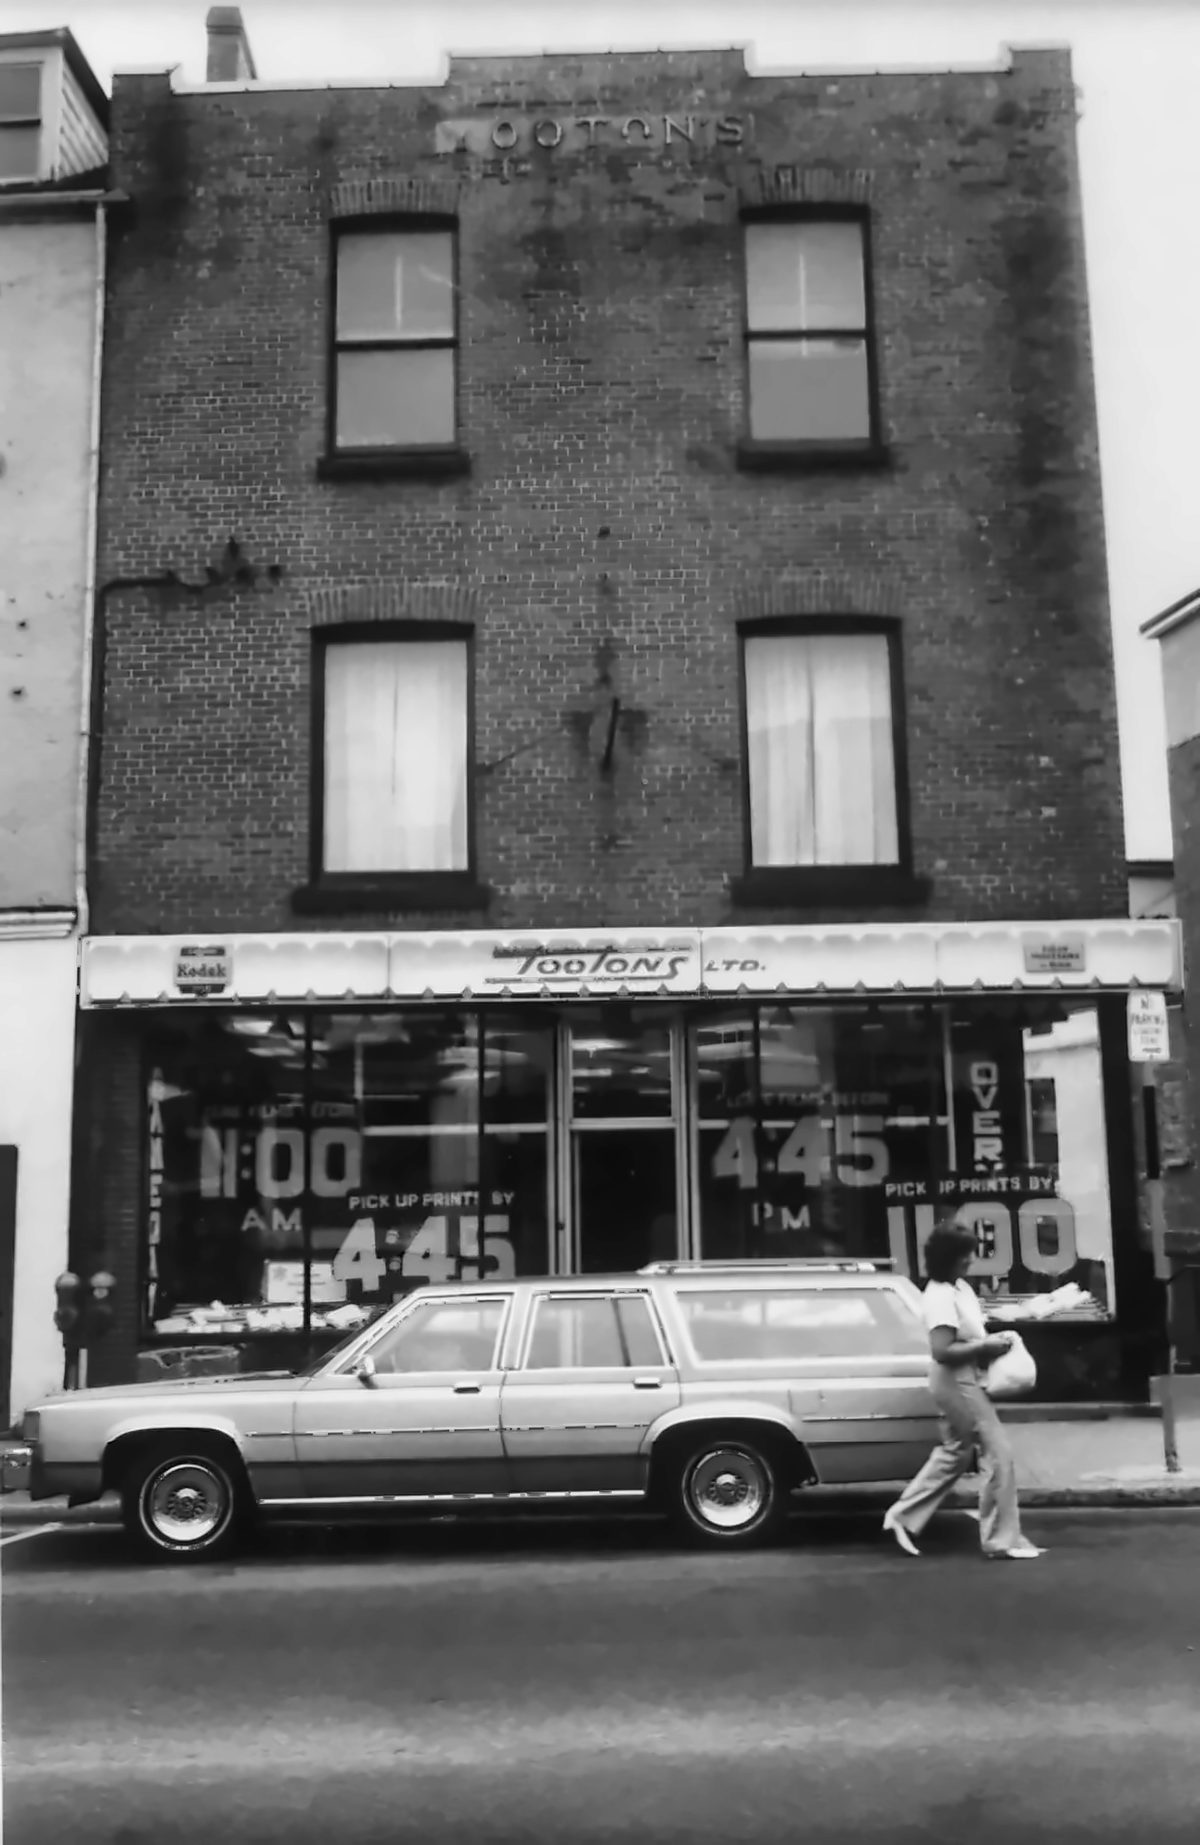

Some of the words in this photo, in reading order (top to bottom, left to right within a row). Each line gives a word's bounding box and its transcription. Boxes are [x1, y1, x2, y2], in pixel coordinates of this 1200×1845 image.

[176, 962, 227, 978] Kodak
[704, 958, 767, 972] LTD.
[885, 1182, 926, 1197] PICK
[959, 1176, 1021, 1193] PRINTS
[1029, 1176, 1052, 1191] BY
[349, 1195, 390, 1210] PICK
[396, 1194, 419, 1207] UP
[491, 1191, 514, 1205] BY
[333, 1215, 516, 1292] 4:45
